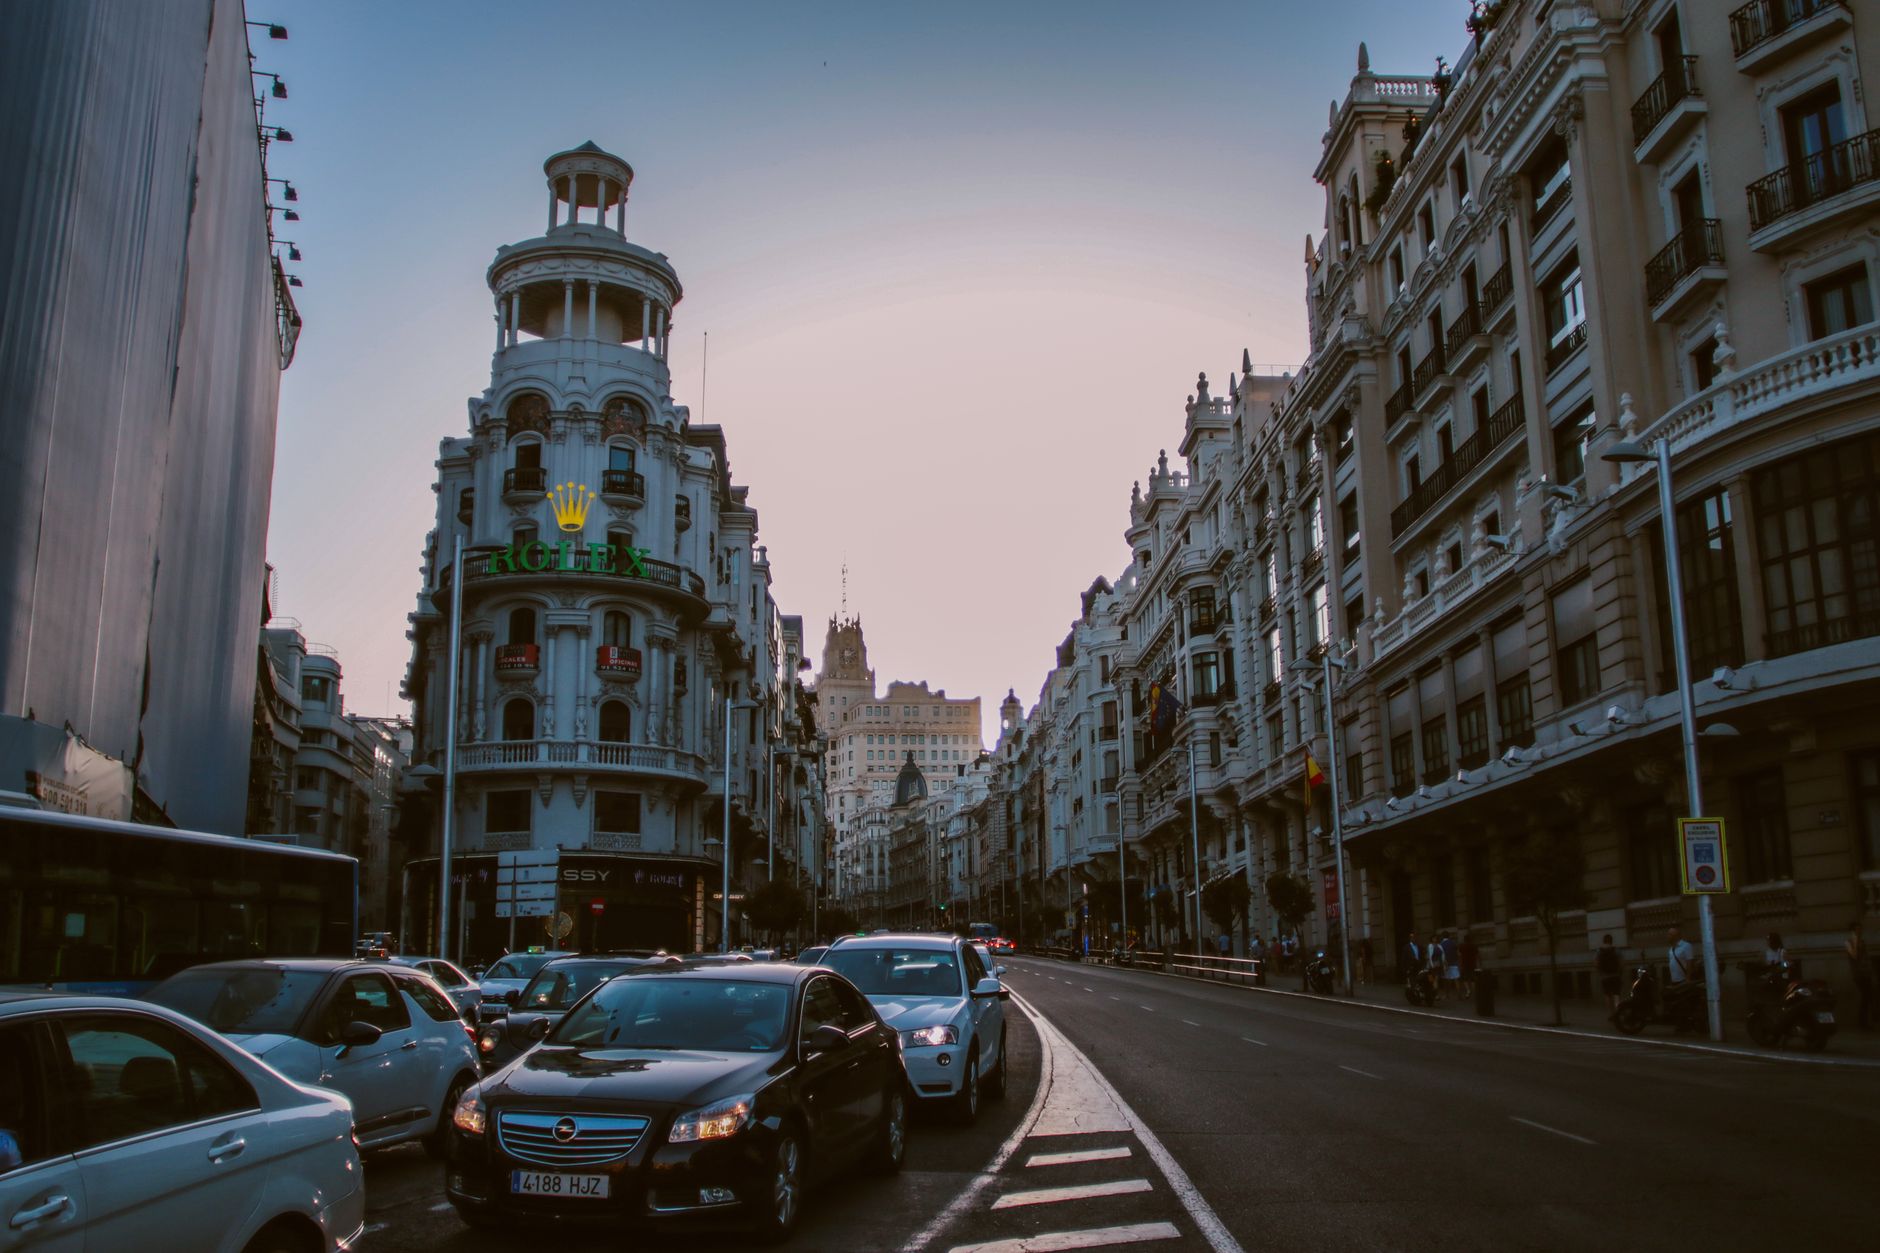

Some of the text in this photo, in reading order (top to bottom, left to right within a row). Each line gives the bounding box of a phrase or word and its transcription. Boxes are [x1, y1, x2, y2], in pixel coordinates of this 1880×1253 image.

[488, 540, 651, 577] ROLEX
[609, 658, 638, 668] OFICINAS
[523, 1174, 601, 1195] 4188 HJZ
